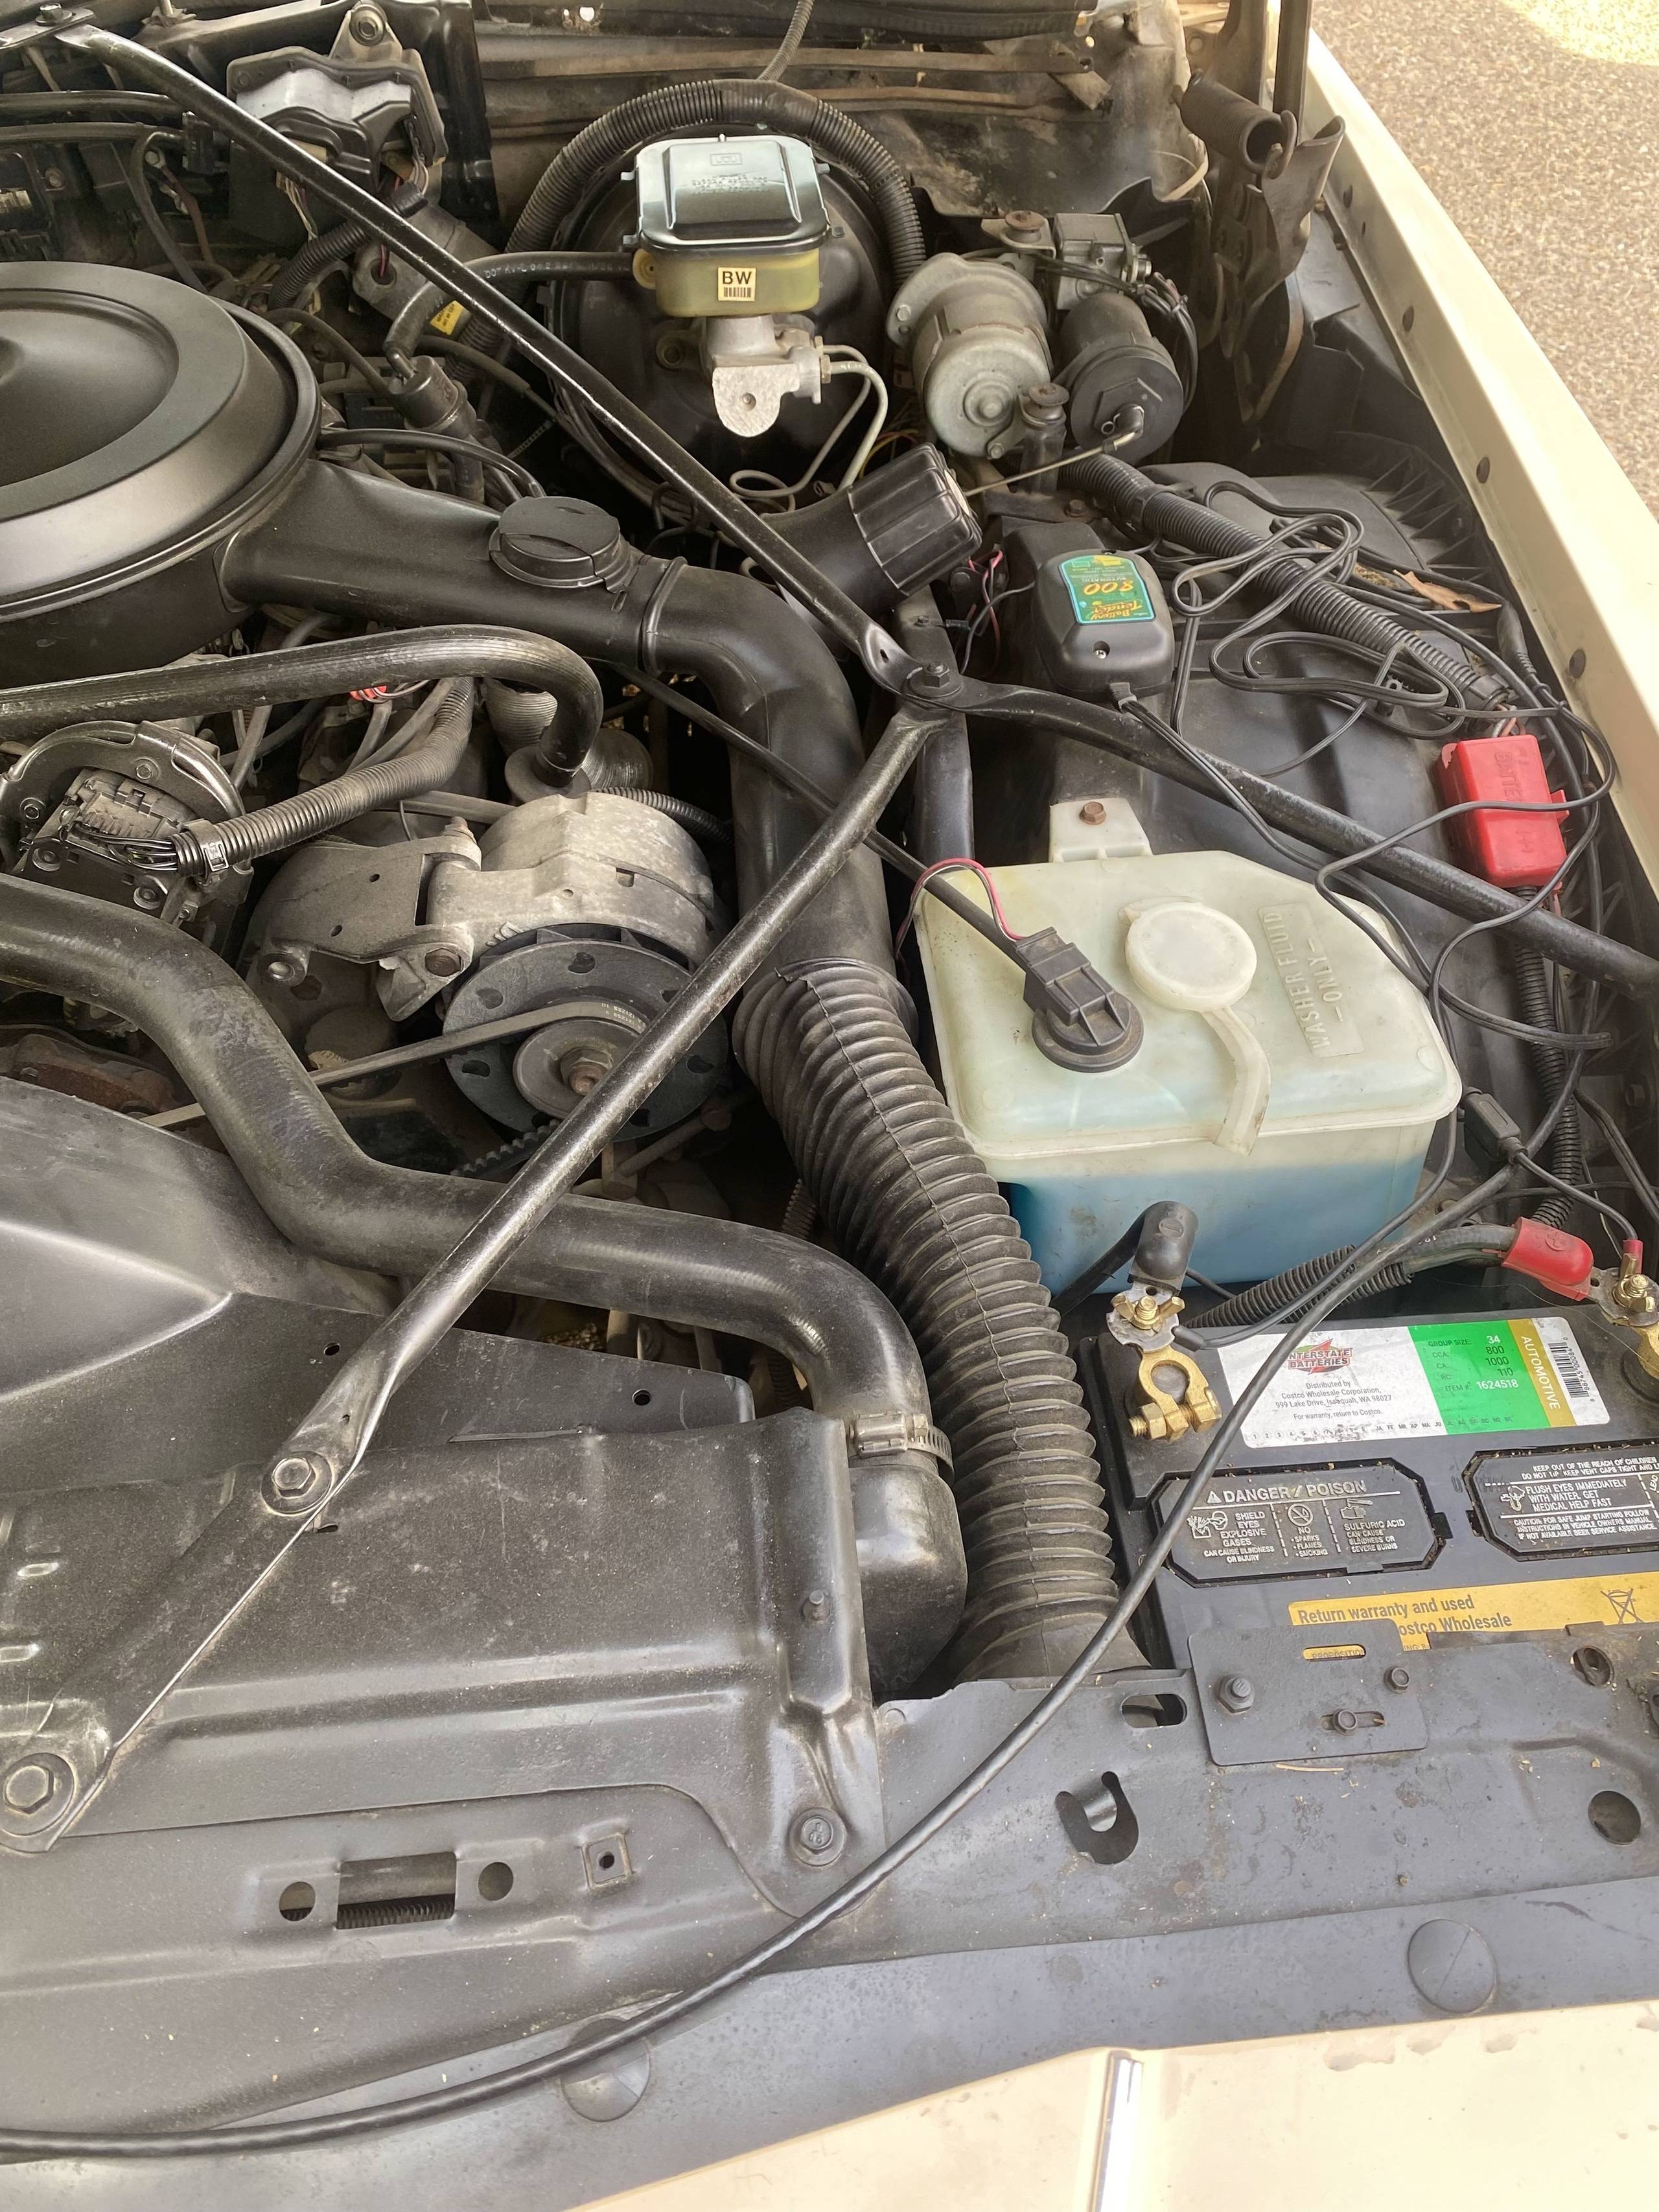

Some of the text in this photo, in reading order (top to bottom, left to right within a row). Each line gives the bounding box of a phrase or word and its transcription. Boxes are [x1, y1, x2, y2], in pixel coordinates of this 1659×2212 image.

[723, 271, 752, 285] BW
[1084, 581, 1133, 596] 800
[1264, 913, 1330, 1049] WASHER FLUID
[1487, 1335, 1500, 1344] 34
[1485, 1345, 1504, 1354] 800
[1290, 1358, 1348, 1368] BATTERIES
[1485, 1356, 1509, 1366] 1000
[1497, 1368, 1513, 1376] 110
[1521, 1336, 1560, 1410] AUTOMOTIVE
[1306, 1380, 1341, 1389] Distributed
[1476, 1379, 1518, 1390] 1624518
[1306, 1389, 1340, 1397] Wholesale
[1341, 1387, 1381, 1395] Corporation,
[1224, 1480, 1367, 1503] DANGER / POISON
[1525, 1479, 1627, 1495] FLUSH EYES IMMEDIATELY
[1528, 1494, 1550, 1504] WITH
[1583, 1490, 1600, 1499] GET
[1531, 1497, 1612, 1512] MEDICAL HELP FAST
[1235, 1511, 1265, 1520] SHIELD
[1592, 1511, 1623, 1520] STARTING
[1344, 1519, 1405, 1531] SULFURIC ACID
[1517, 1524, 1562, 1533] INSTRUCTIONS
[1570, 1521, 1596, 1530] VEHICLE
[1220, 1528, 1266, 1539] EXPLOSIVE
[1590, 1526, 1618, 1535] SERVICE
[1223, 1538, 1251, 1547] GASES
[1349, 1537, 1384, 1545] BLINDNESS
[1240, 1546, 1275, 1554] BLINDNESS
[1351, 1544, 1376, 1553] SEVERE
[1298, 1594, 1476, 1624] Return warranty and used
[1399, 1612, 1512, 1636] ostco Wholesale
